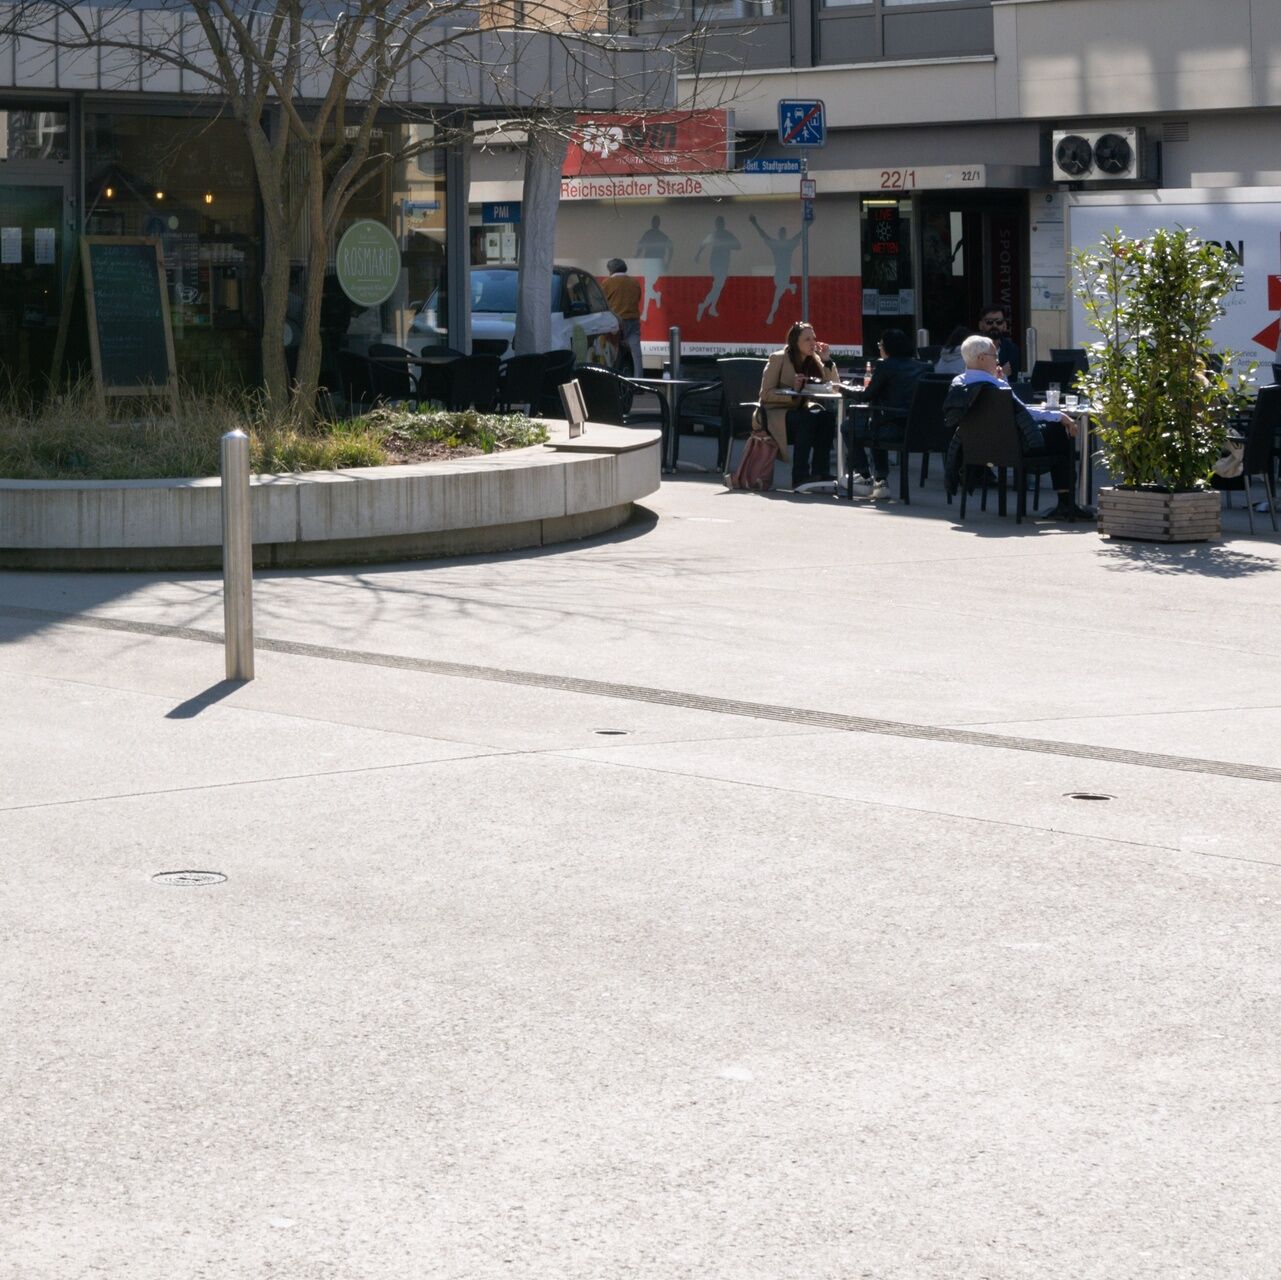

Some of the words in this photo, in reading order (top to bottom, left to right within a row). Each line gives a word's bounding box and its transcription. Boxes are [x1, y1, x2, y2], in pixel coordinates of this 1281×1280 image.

[762, 159, 799, 174] Stadtgraben
[559, 178, 652, 199] Reichsstädter
[656, 177, 702, 197] Straße
[881, 170, 916, 190] 22/1
[962, 171, 980, 182] 22/1
[494, 206, 509, 218] PMI
[344, 247, 394, 276] ROSMARIE
